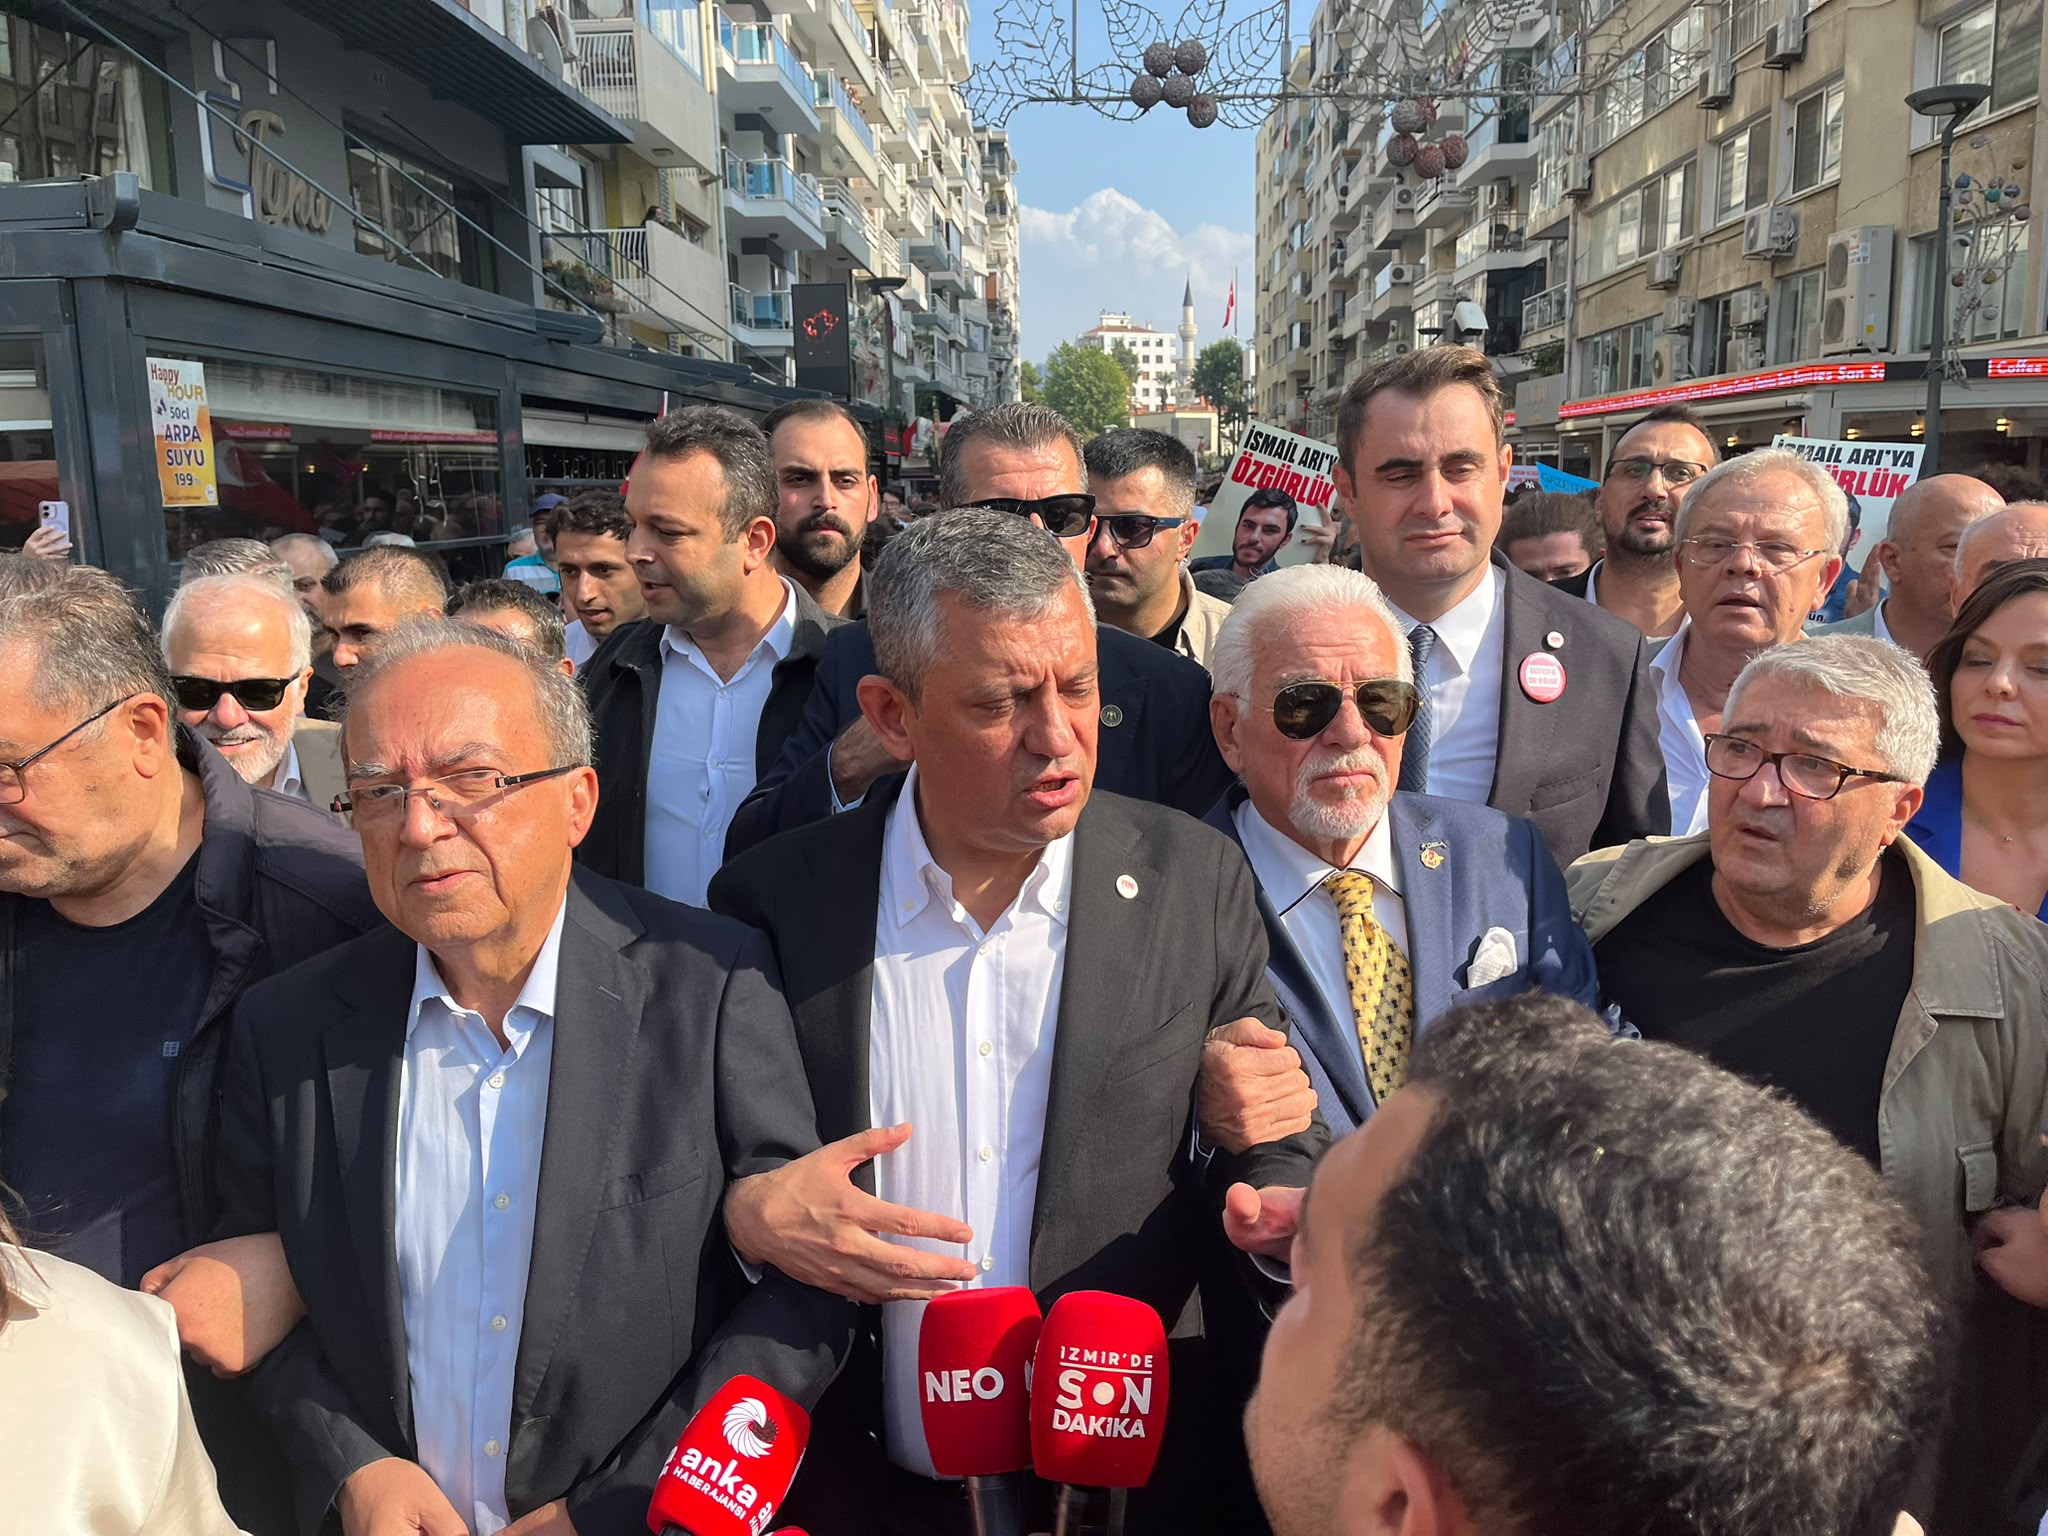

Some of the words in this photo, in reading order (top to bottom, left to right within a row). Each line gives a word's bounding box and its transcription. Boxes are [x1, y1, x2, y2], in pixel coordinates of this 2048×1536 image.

[151, 363, 179, 385] Happy
[1997, 359, 2042, 373] Coffee
[167, 383, 204, 402] HOUR
[170, 406, 190, 420] 50cl
[165, 424, 202, 443] ARPA
[166, 449, 205, 466] SUYU
[1243, 425, 1298, 464] İSMAİL
[1298, 446, 1339, 476] ARI'Y
[1847, 448, 1916, 469] ARI'YA
[174, 473, 194, 486] 199
[1231, 450, 1336, 509] ÖZGÜRLÜK
[924, 1367, 1005, 1403] NEO
[680, 1447, 759, 1509] anka
